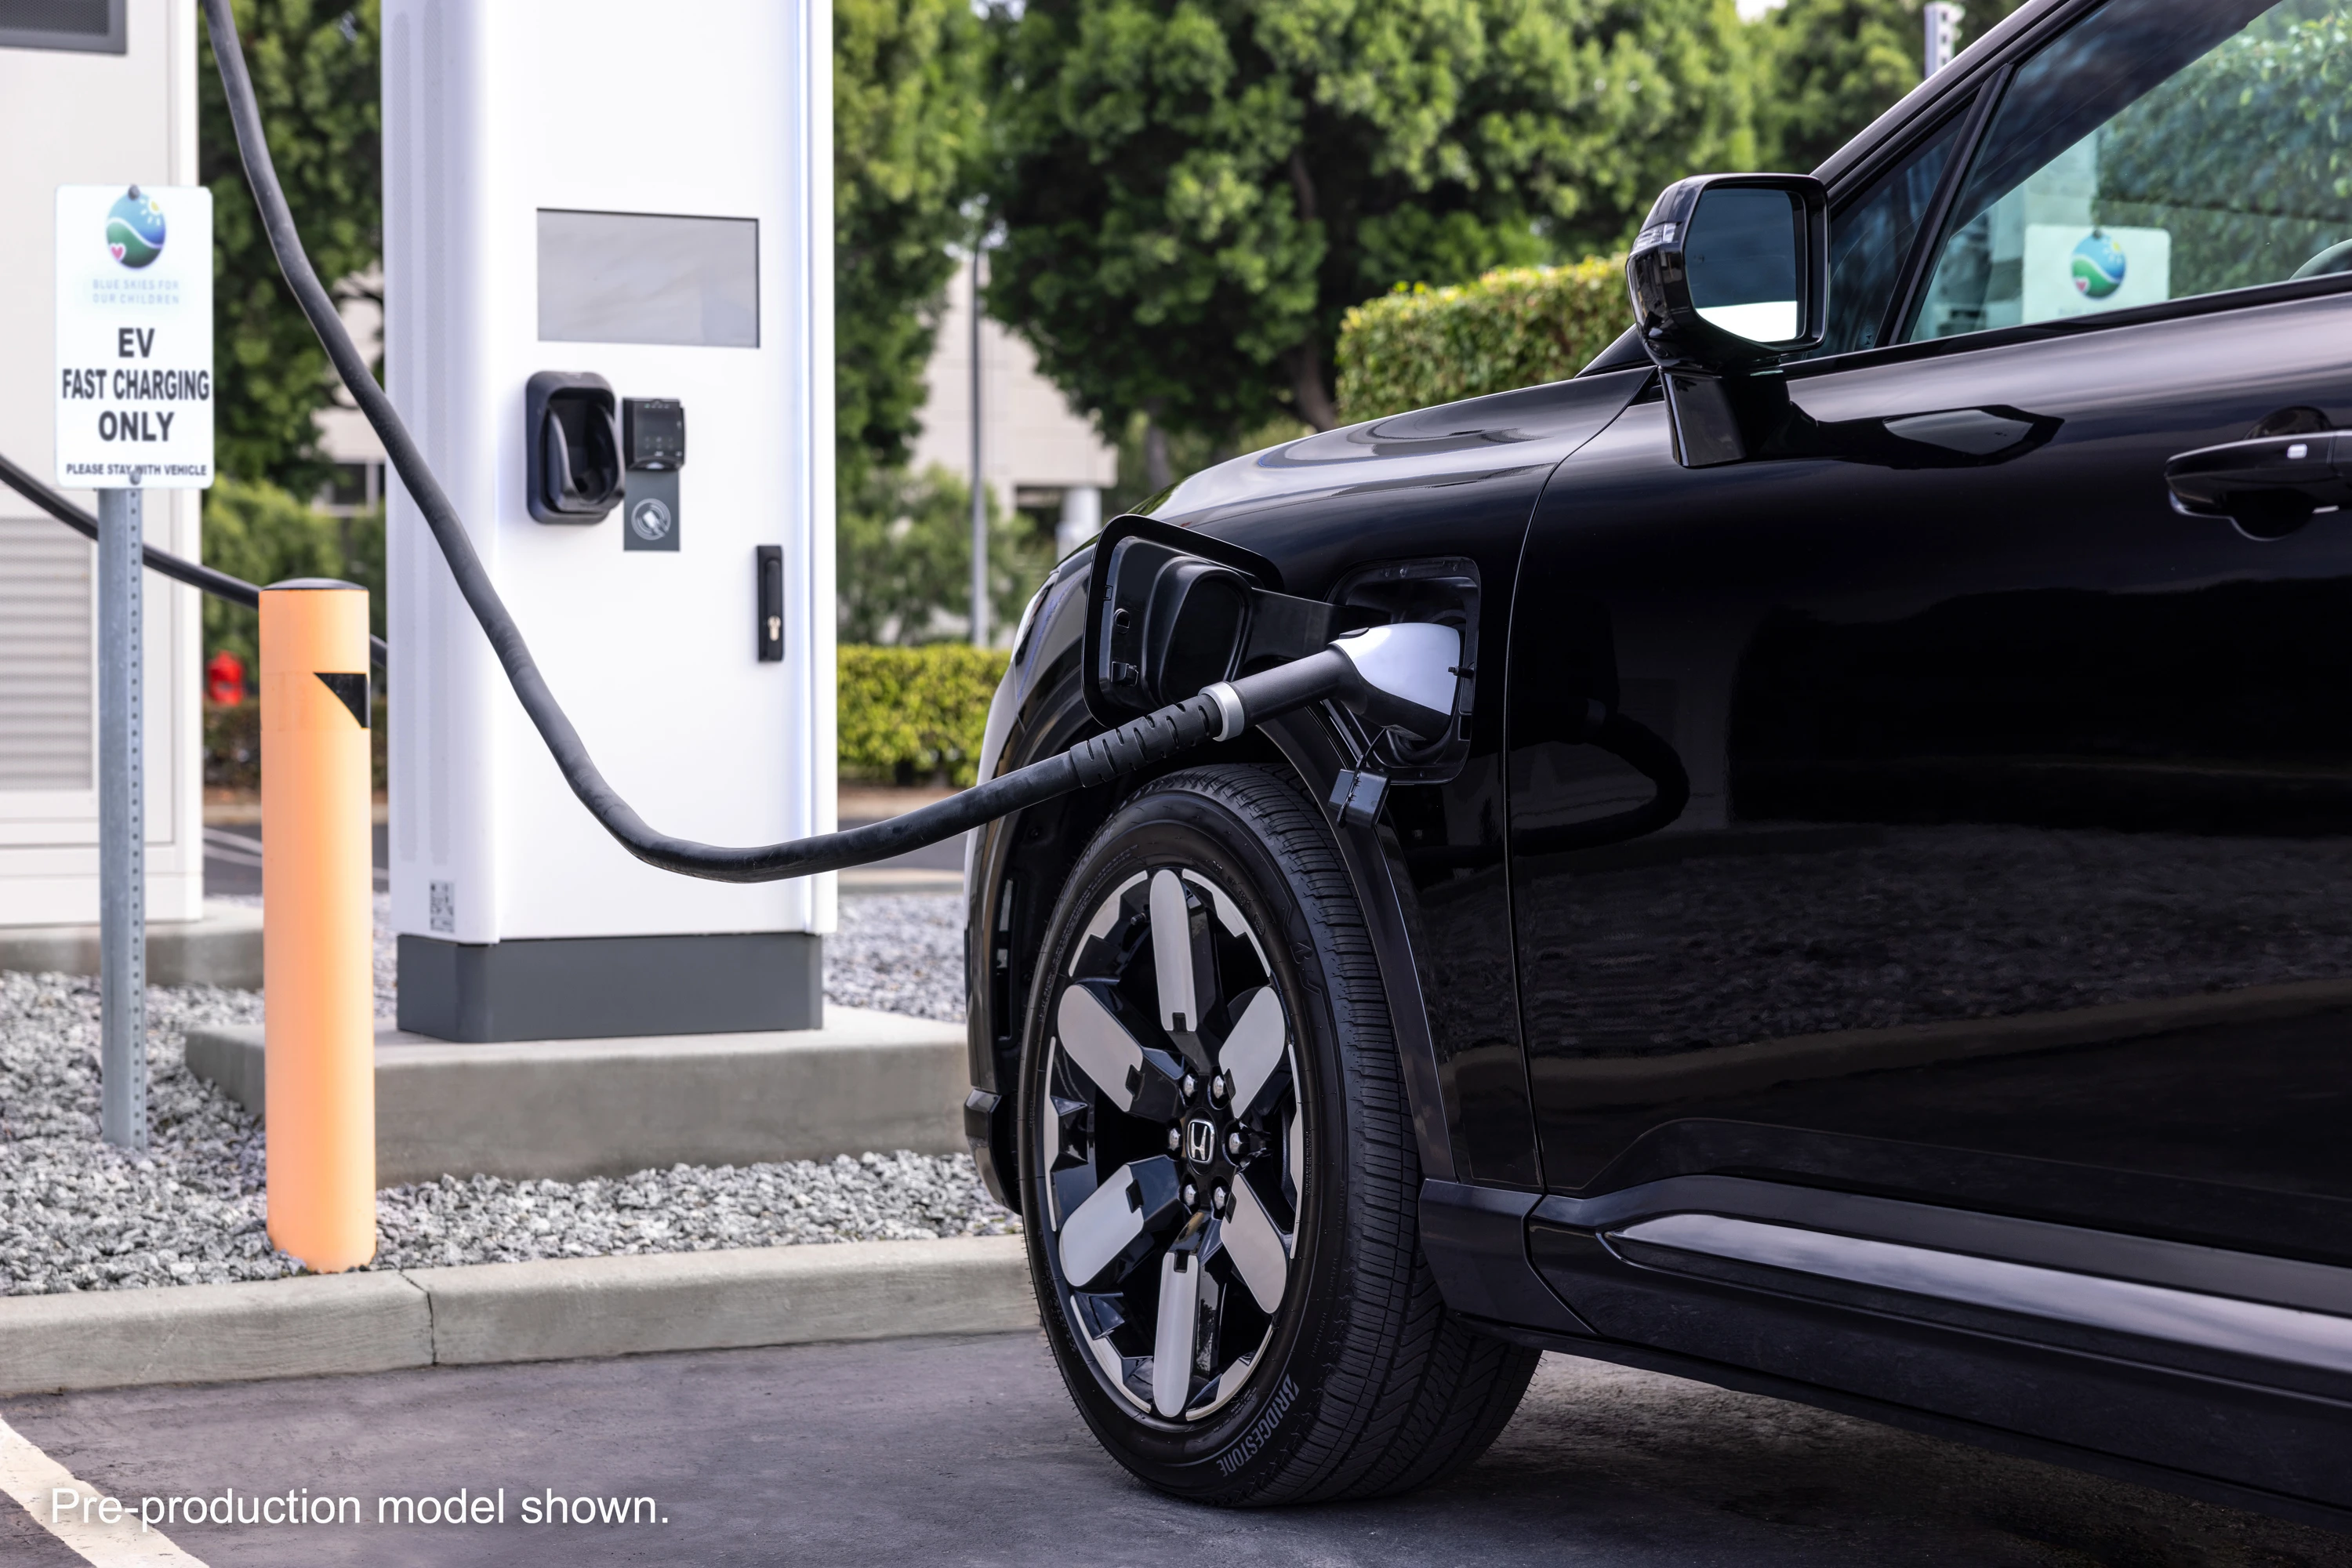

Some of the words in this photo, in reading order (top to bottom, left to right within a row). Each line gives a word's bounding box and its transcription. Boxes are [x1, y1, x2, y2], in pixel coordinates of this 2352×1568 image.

[92, 278, 119, 290] BLUE
[123, 279, 155, 290] SKIES
[158, 280, 180, 291] FOR
[93, 293, 116, 304] OUR
[119, 293, 180, 305] CHILDREN
[118, 327, 155, 358] EV
[62, 368, 107, 400] FAST
[113, 369, 210, 401] CHARGING
[98, 410, 175, 442] ONLY
[66, 463, 104, 475] PLEASE
[107, 464, 132, 476] STAY
[133, 464, 162, 475] WITH
[164, 464, 207, 477] VEHICLE
[1216, 1374, 1300, 1477] BRIDGESTONE
